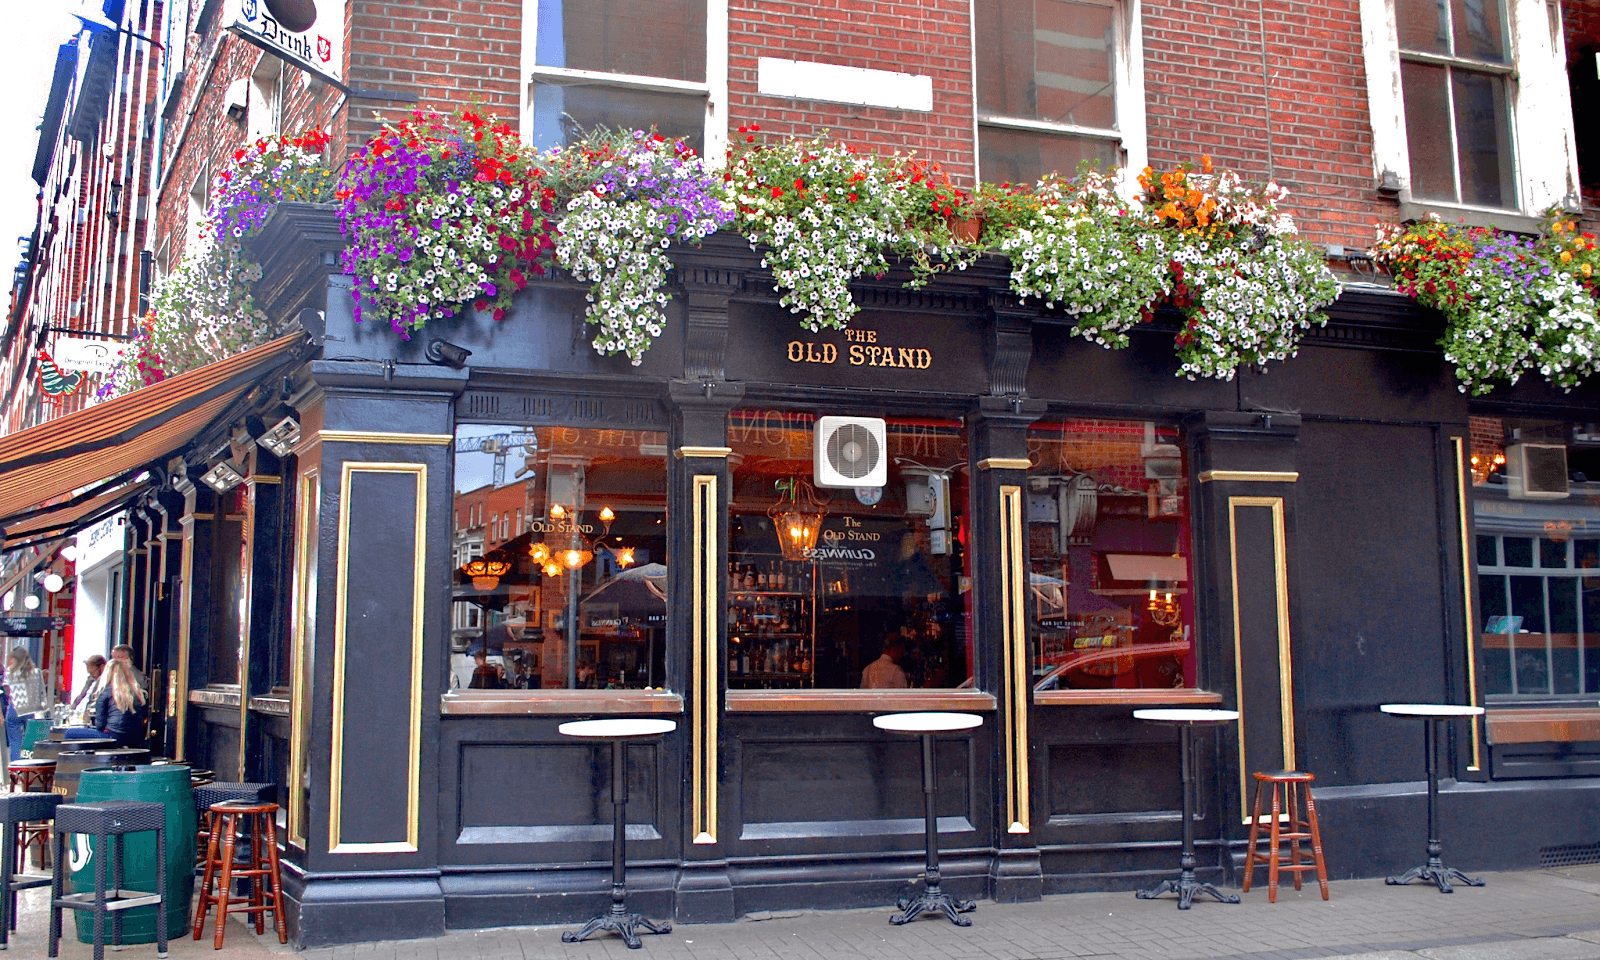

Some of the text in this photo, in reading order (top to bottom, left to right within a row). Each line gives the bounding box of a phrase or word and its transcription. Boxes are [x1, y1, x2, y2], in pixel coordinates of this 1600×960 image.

[261, 12, 312, 60] Drink
[844, 328, 877, 343] THE
[787, 340, 932, 369] OLD STAND
[843, 516, 862, 527] The
